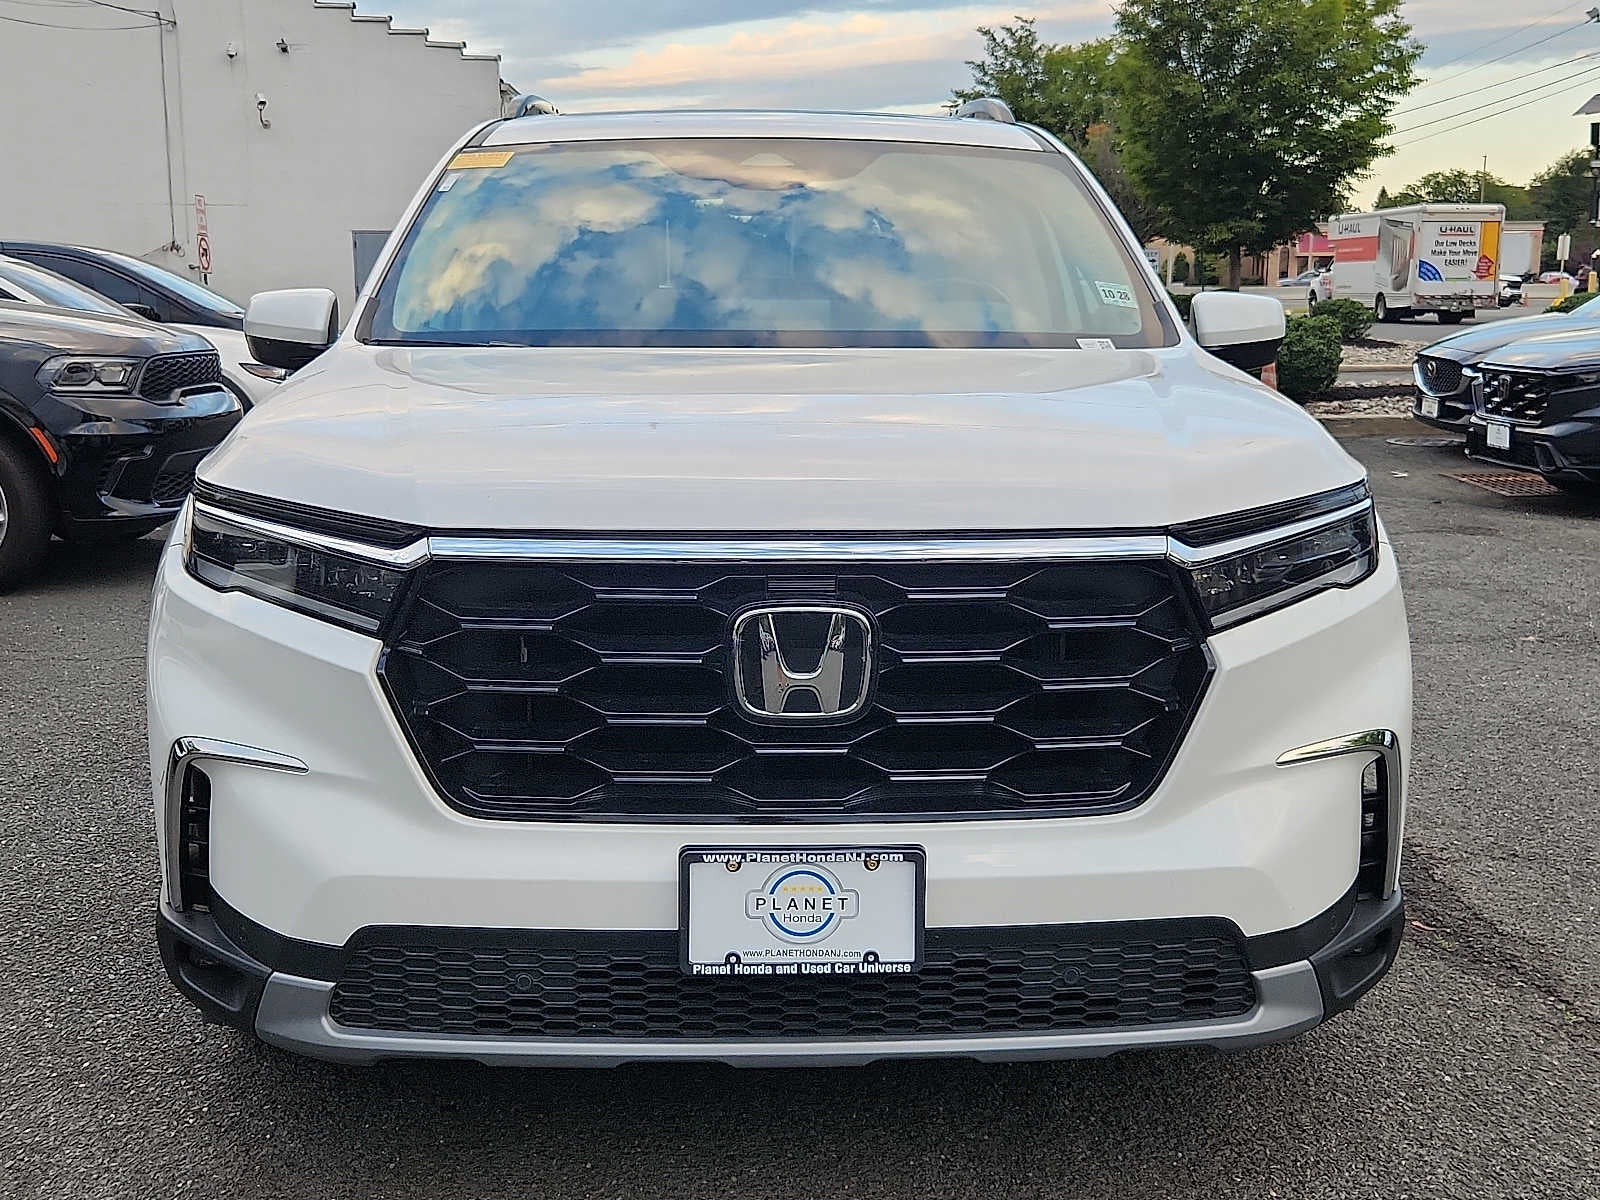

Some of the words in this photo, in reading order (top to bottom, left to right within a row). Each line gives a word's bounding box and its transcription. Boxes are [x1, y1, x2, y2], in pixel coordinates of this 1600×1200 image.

[1102, 289, 1116, 299] 10
[702, 852, 904, 863] www.PlanetHondaNJ.com
[754, 897, 849, 911] PLANET
[783, 913, 823, 924] Honda
[742, 948, 862, 958] www.PLANETHONDANJ.com
[692, 963, 731, 975] Planet
[734, 963, 773, 975] Honda
[775, 963, 798, 975] and
[801, 963, 832, 974] Used
[834, 963, 856, 974] Car
[859, 962, 912, 974] Universe
